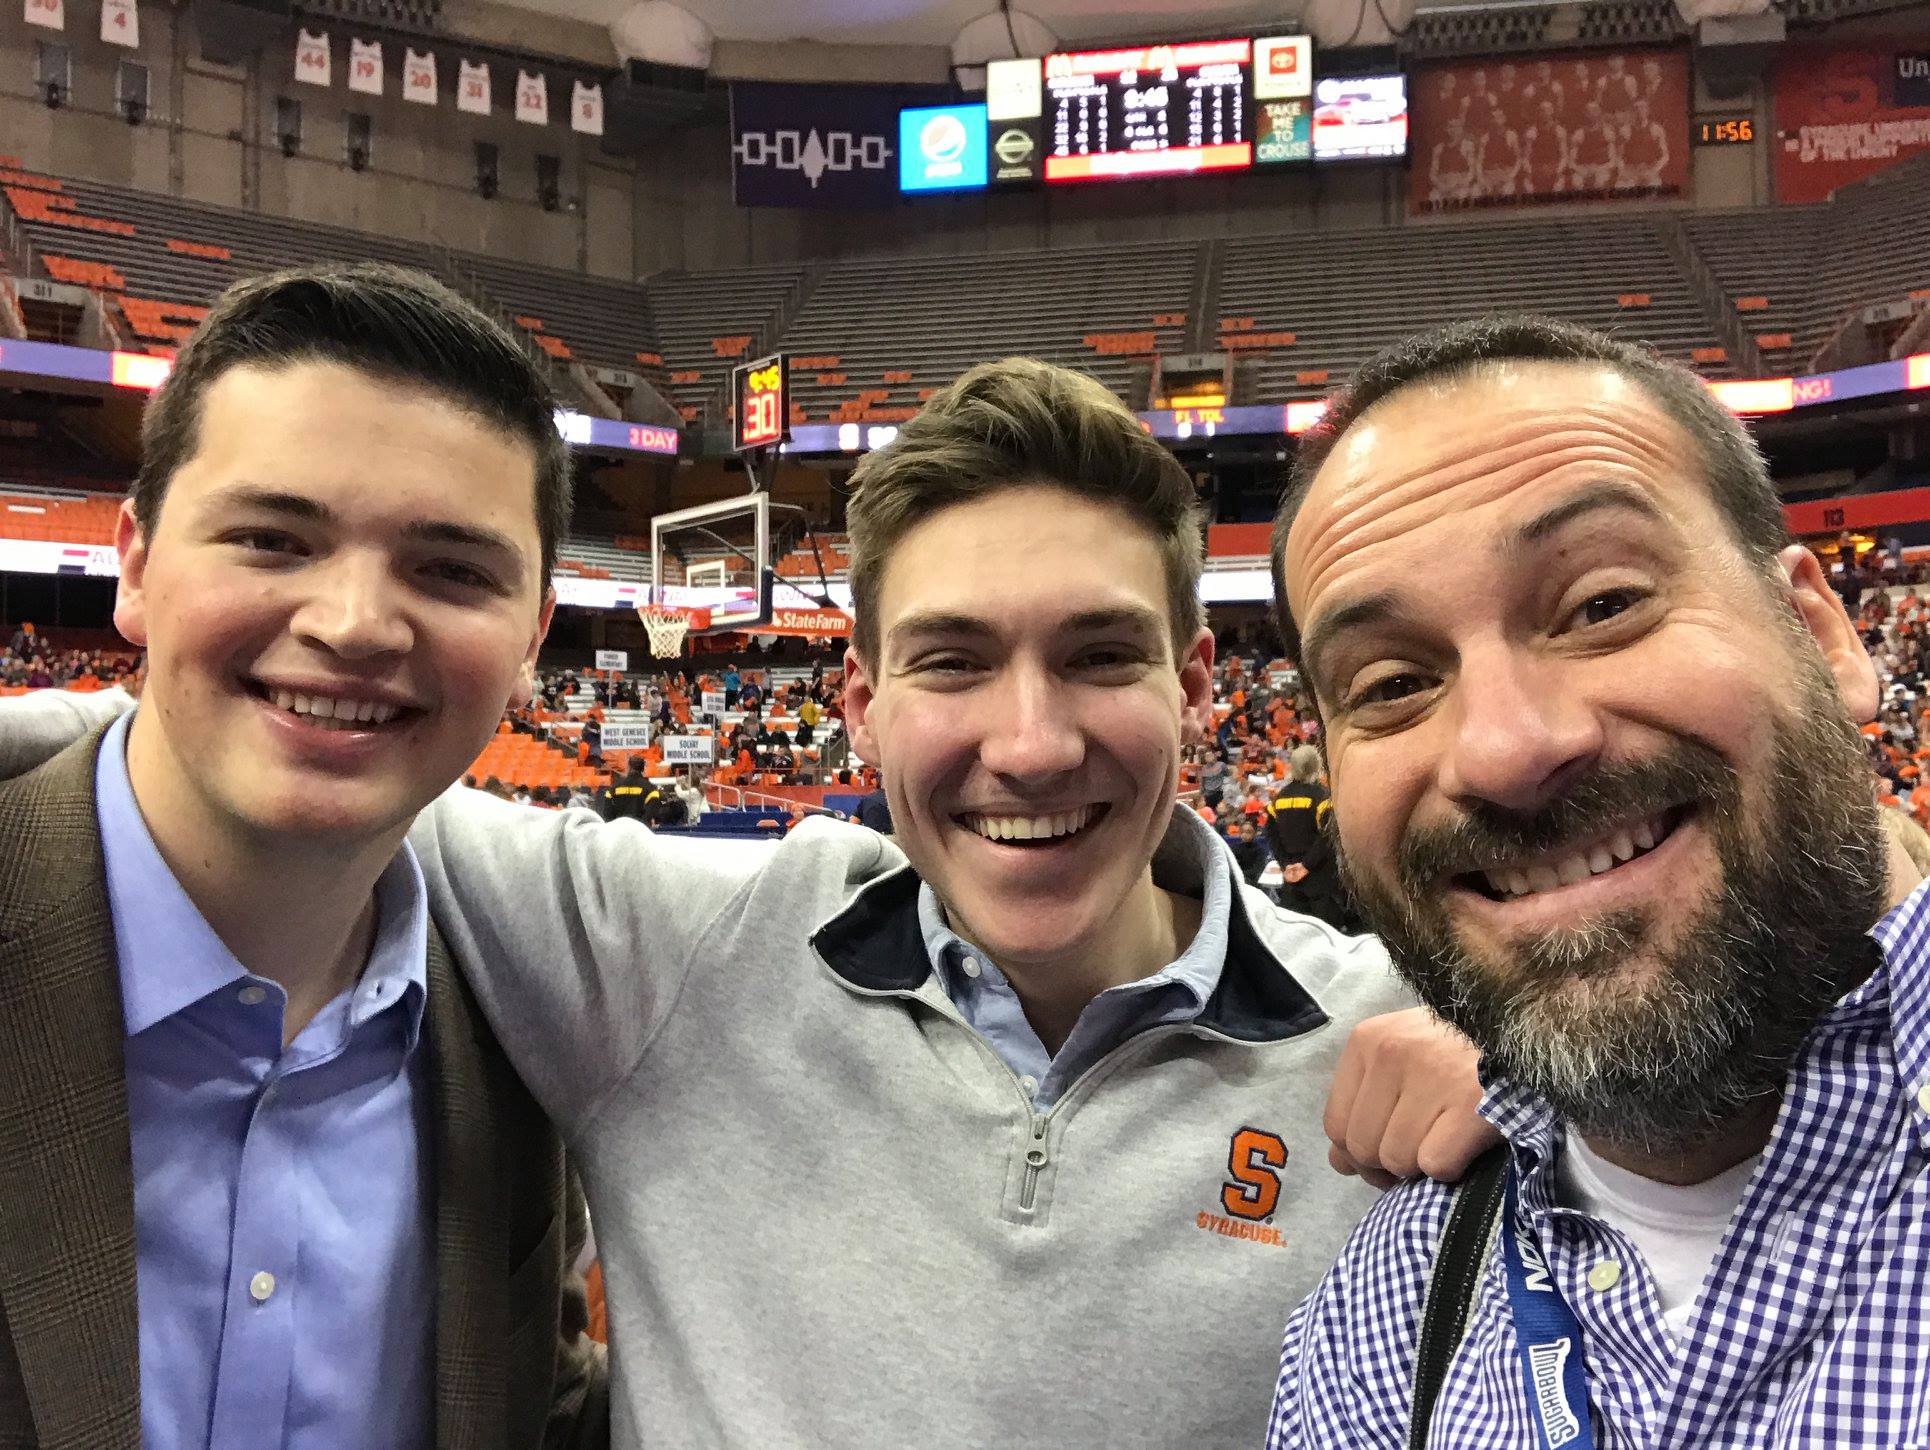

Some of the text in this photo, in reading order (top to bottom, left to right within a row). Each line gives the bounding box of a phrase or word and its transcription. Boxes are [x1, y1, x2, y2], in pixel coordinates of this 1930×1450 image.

[301, 52, 325, 69] 44
[1264, 102, 1301, 118] TAKE
[1272, 116, 1294, 130] ME
[1702, 120, 1753, 142] 11:56
[1273, 130, 1294, 144] TO
[748, 393, 775, 438] 30
[630, 427, 678, 450] 3 DAY
[1220, 1125, 1289, 1222] S
[1195, 1210, 1285, 1247] SYRACUSE
